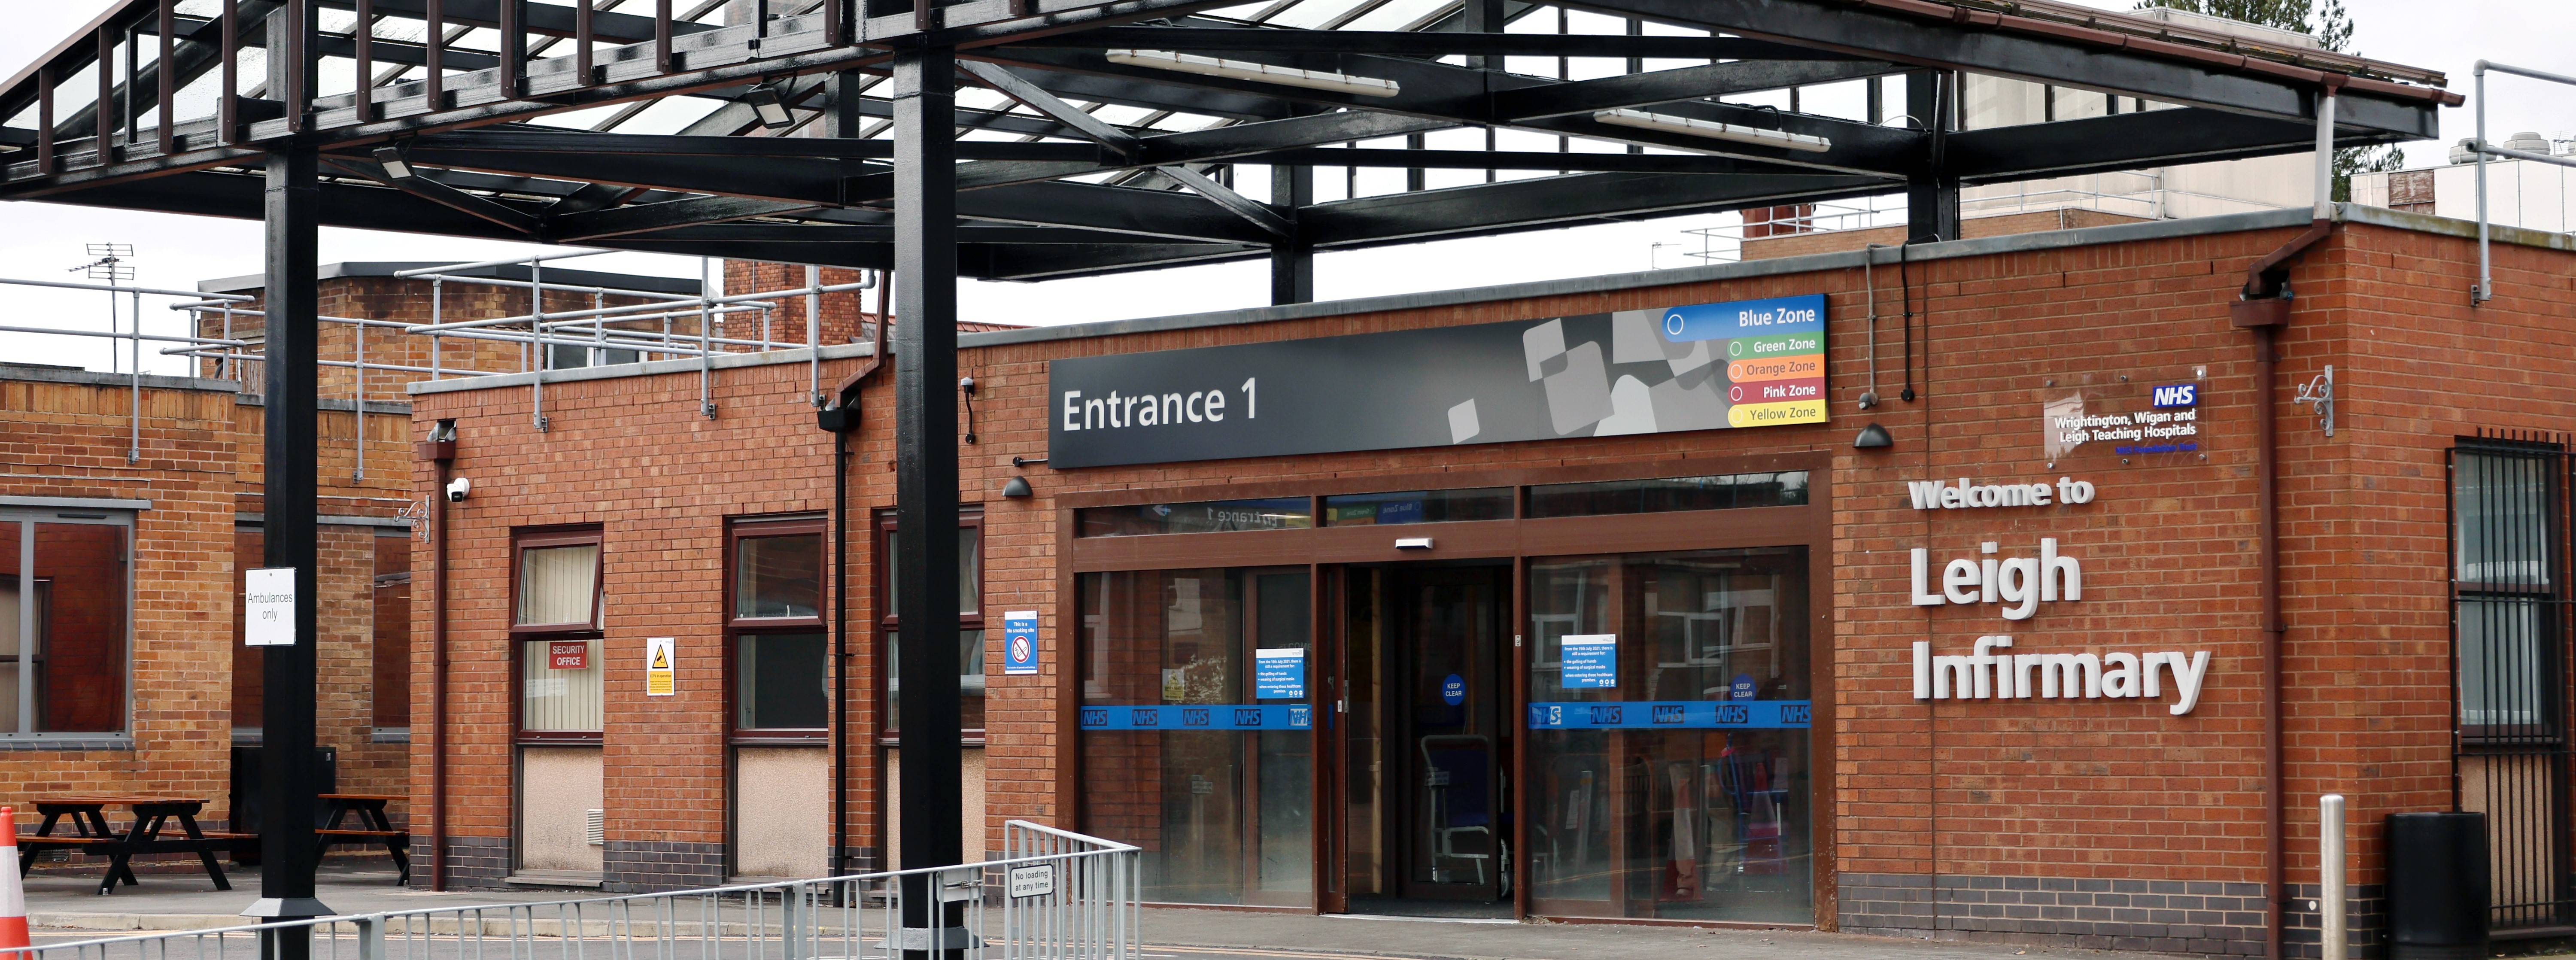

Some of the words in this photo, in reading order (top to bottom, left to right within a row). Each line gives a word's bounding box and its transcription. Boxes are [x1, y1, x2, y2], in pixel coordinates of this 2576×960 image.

[1739, 309, 1772, 327] Blue
[1777, 308, 1815, 324] Zone
[1754, 342, 1785, 352] Green
[1789, 339, 1815, 350] Zone
[1747, 363, 1786, 376] Orange
[1789, 362, 1815, 372] Zone
[1764, 385, 1786, 398] Pink
[1789, 385, 1816, 396] Zone
[2154, 386, 2193, 406] NHS
[1064, 389, 1225, 431] Entrance
[1241, 377, 1255, 419] 1
[1750, 408, 1786, 420] Yellow
[1789, 407, 1816, 418] Zone
[2054, 415, 2131, 430] Wrightington,
[2134, 412, 2171, 425] Wigan
[2174, 408, 2196, 421] and
[2060, 430, 2089, 444] Leigh
[2092, 427, 2141, 441] Teaching
[2145, 423, 2196, 439] Hospitals
[1908, 478, 2052, 510] Welcome
[2057, 477, 2095, 504] to
[1911, 538, 2081, 620] Leigh
[248, 592, 292, 604] Ambulances
[262, 608, 278, 622] only
[553, 645, 584, 654] SECURITY
[556, 657, 580, 665] OFFICE
[1913, 635, 2211, 715] Infirmary
[1084, 711, 1106, 724] NHS
[1133, 710, 1156, 724] NHS
[1184, 710, 1207, 724] NHS
[1236, 711, 1260, 724] NHS
[1532, 708, 1559, 723] NHS
[1592, 708, 1620, 723] NHS
[1654, 707, 1683, 722] NHS
[1716, 707, 1746, 722] NHS
[1782, 707, 1811, 722] NHS
[1026, 870, 1048, 878] loading
[1023, 883, 1033, 891] any
